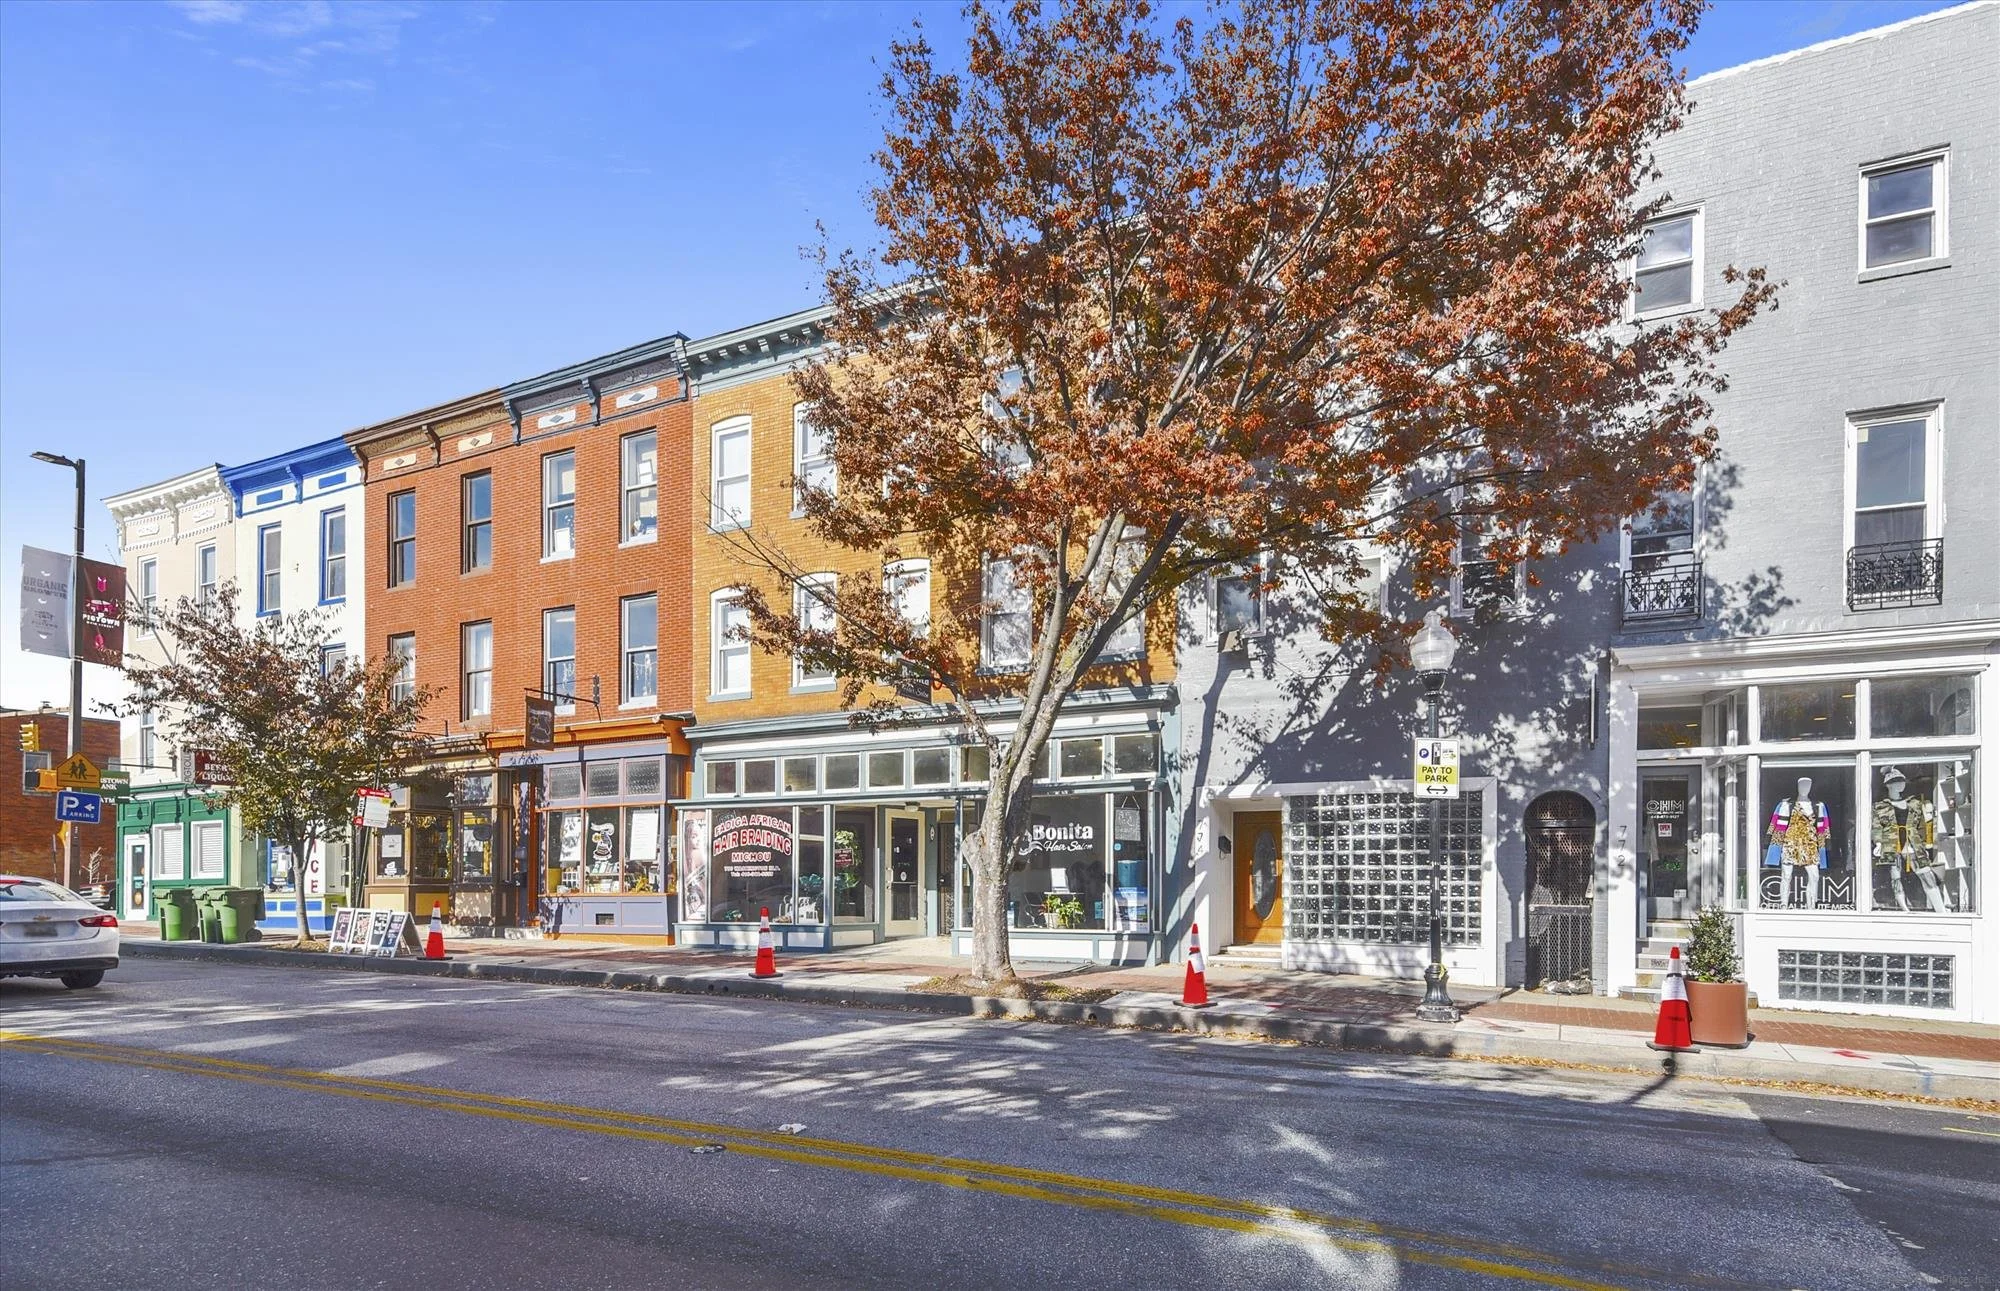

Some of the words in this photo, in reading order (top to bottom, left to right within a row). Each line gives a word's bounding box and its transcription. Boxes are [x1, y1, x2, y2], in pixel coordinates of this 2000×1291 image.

[83, 613, 120, 627] PIGTOWN
[184, 752, 192, 784] PIGTOW
[204, 763, 228, 772] BEER
[1421, 766, 1438, 774] PAY
[1440, 766, 1453, 775] TO
[100, 777, 129, 785] STOWN
[1424, 774, 1449, 783] PARK
[1646, 799, 1685, 811] OHM
[714, 815, 748, 838] FADIGA
[749, 814, 792, 835] AFRICAN
[1032, 822, 1094, 841] Bonita
[713, 831, 739, 857] HAIR
[740, 828, 792, 856] BRAIDING
[1043, 840, 1067, 852] Hair
[1067, 840, 1094, 852] Salon
[1616, 825, 1628, 867] 772
[731, 851, 772, 863] MICHOU
